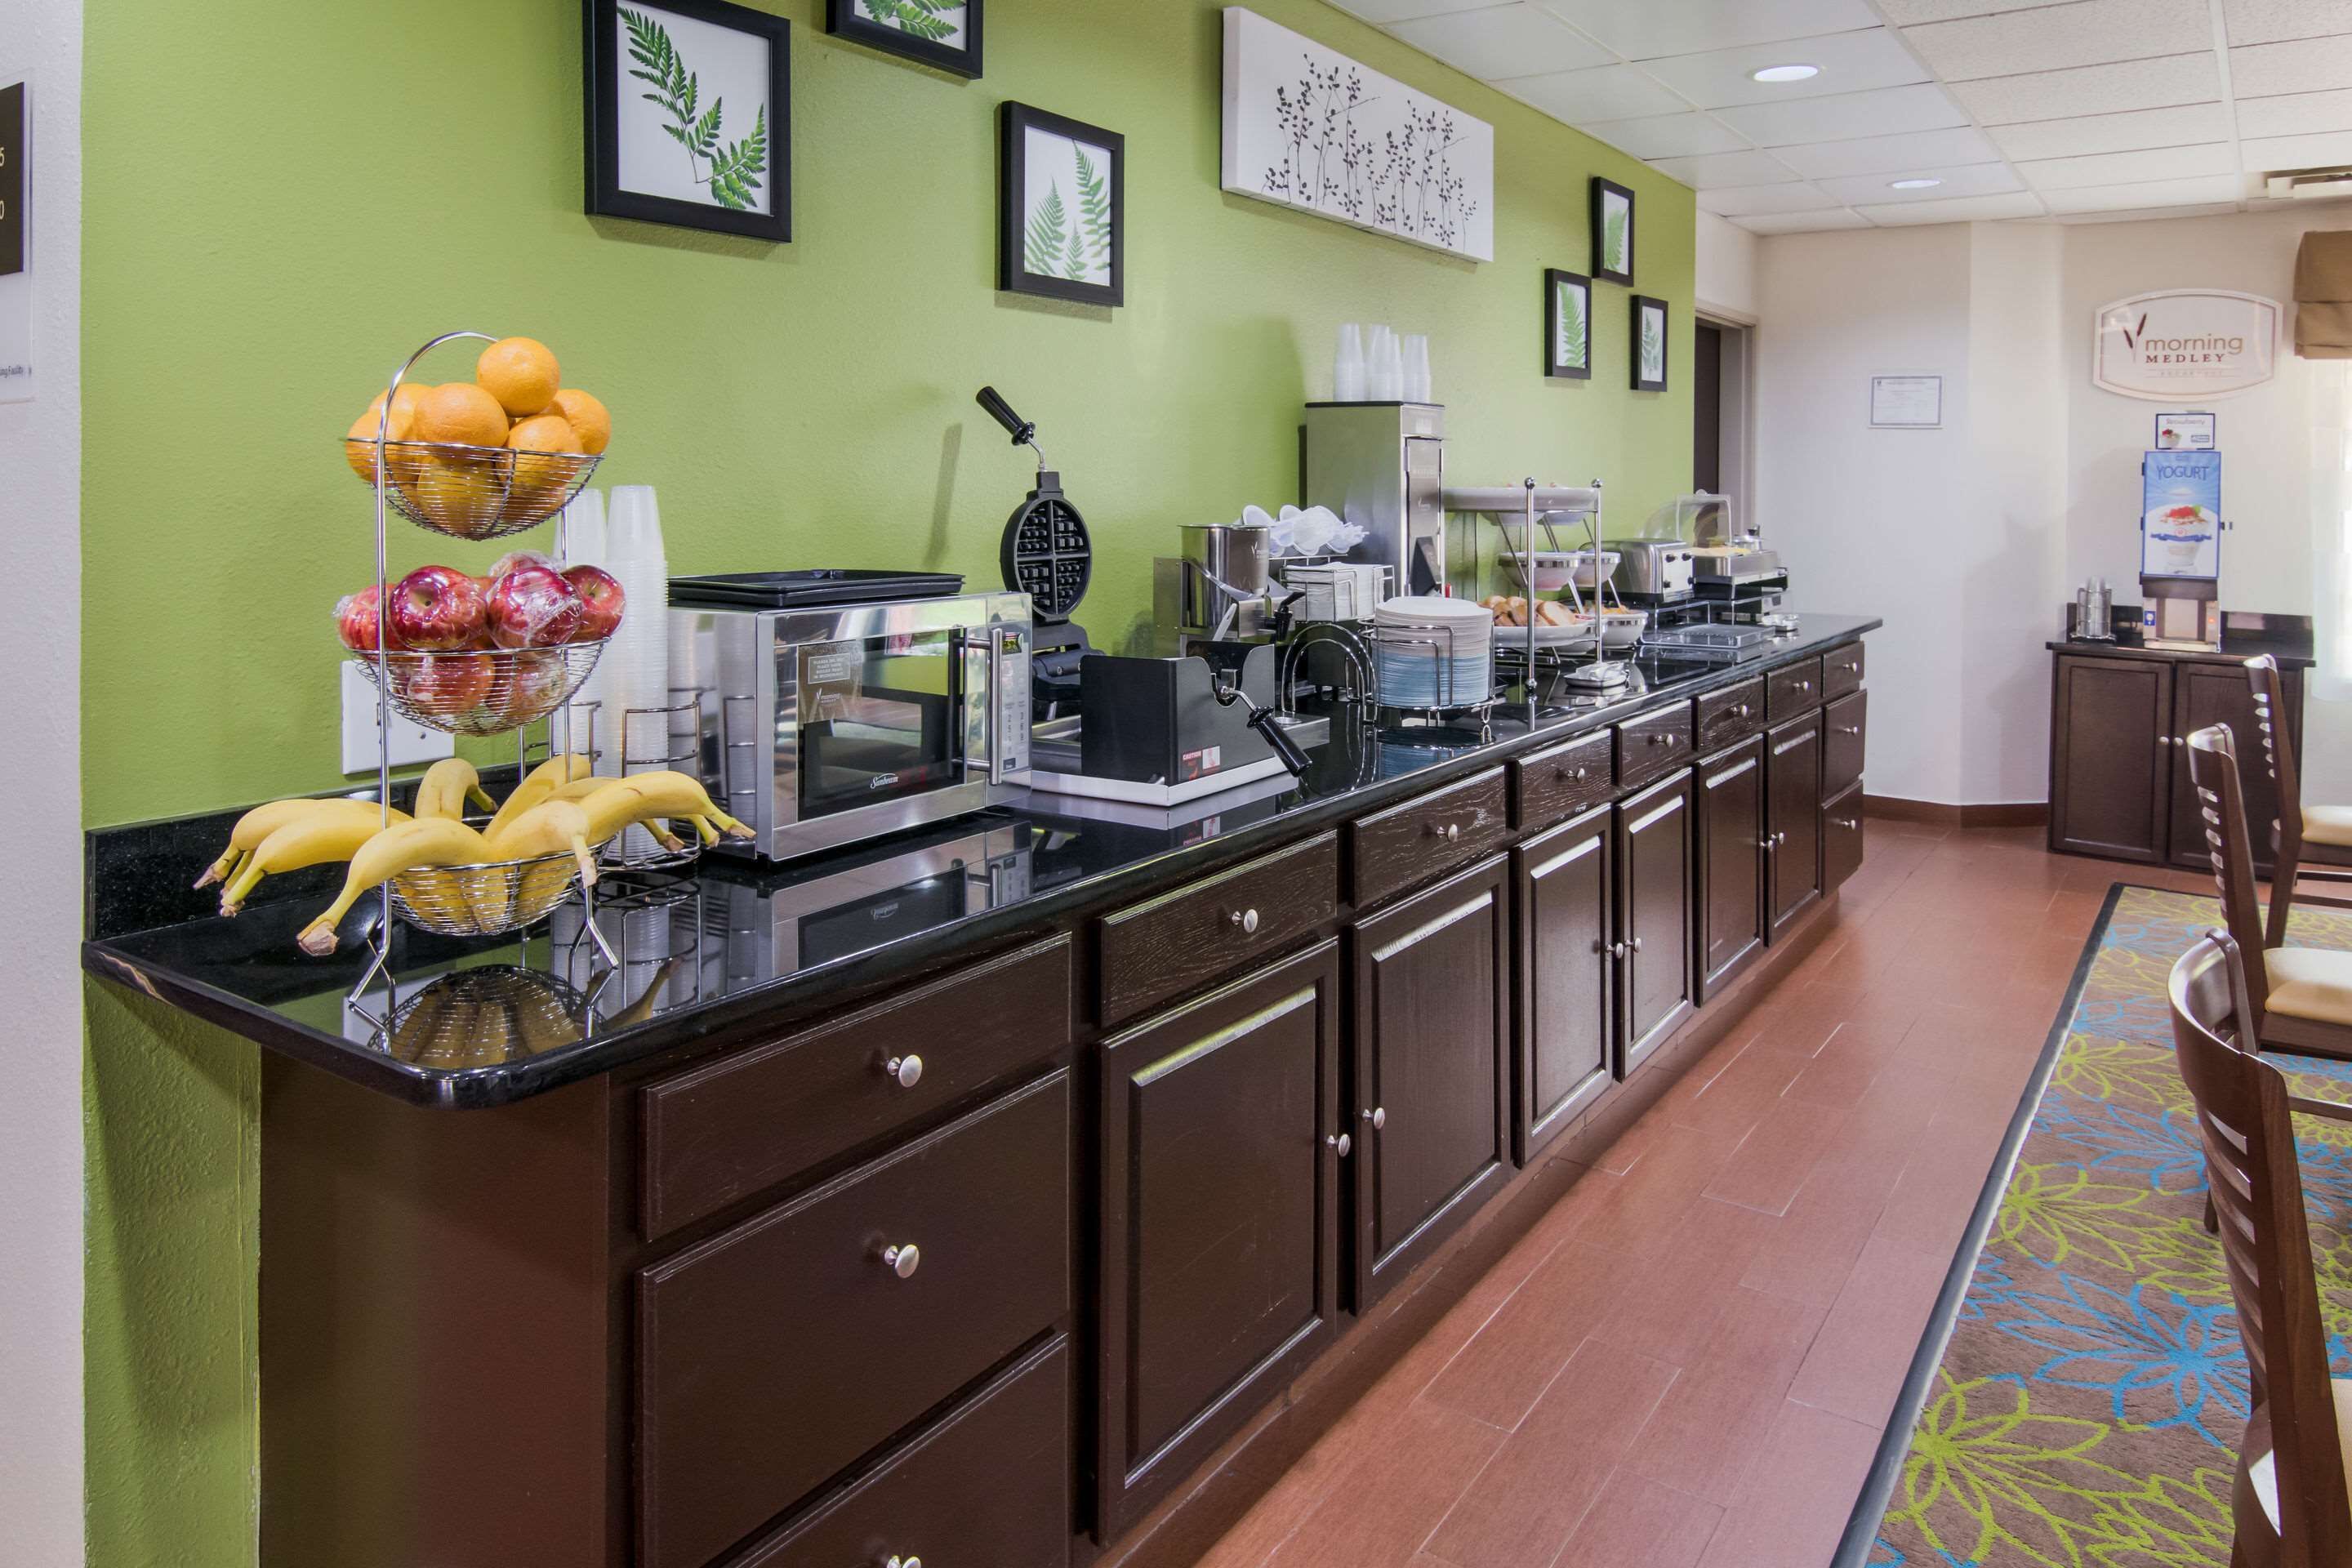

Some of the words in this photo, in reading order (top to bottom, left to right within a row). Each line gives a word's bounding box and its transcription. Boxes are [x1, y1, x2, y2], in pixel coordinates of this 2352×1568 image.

[2145, 333, 2243, 355] morning
[2145, 354, 2225, 363] MEDLEY
[2156, 466, 2210, 481] YOGURT
